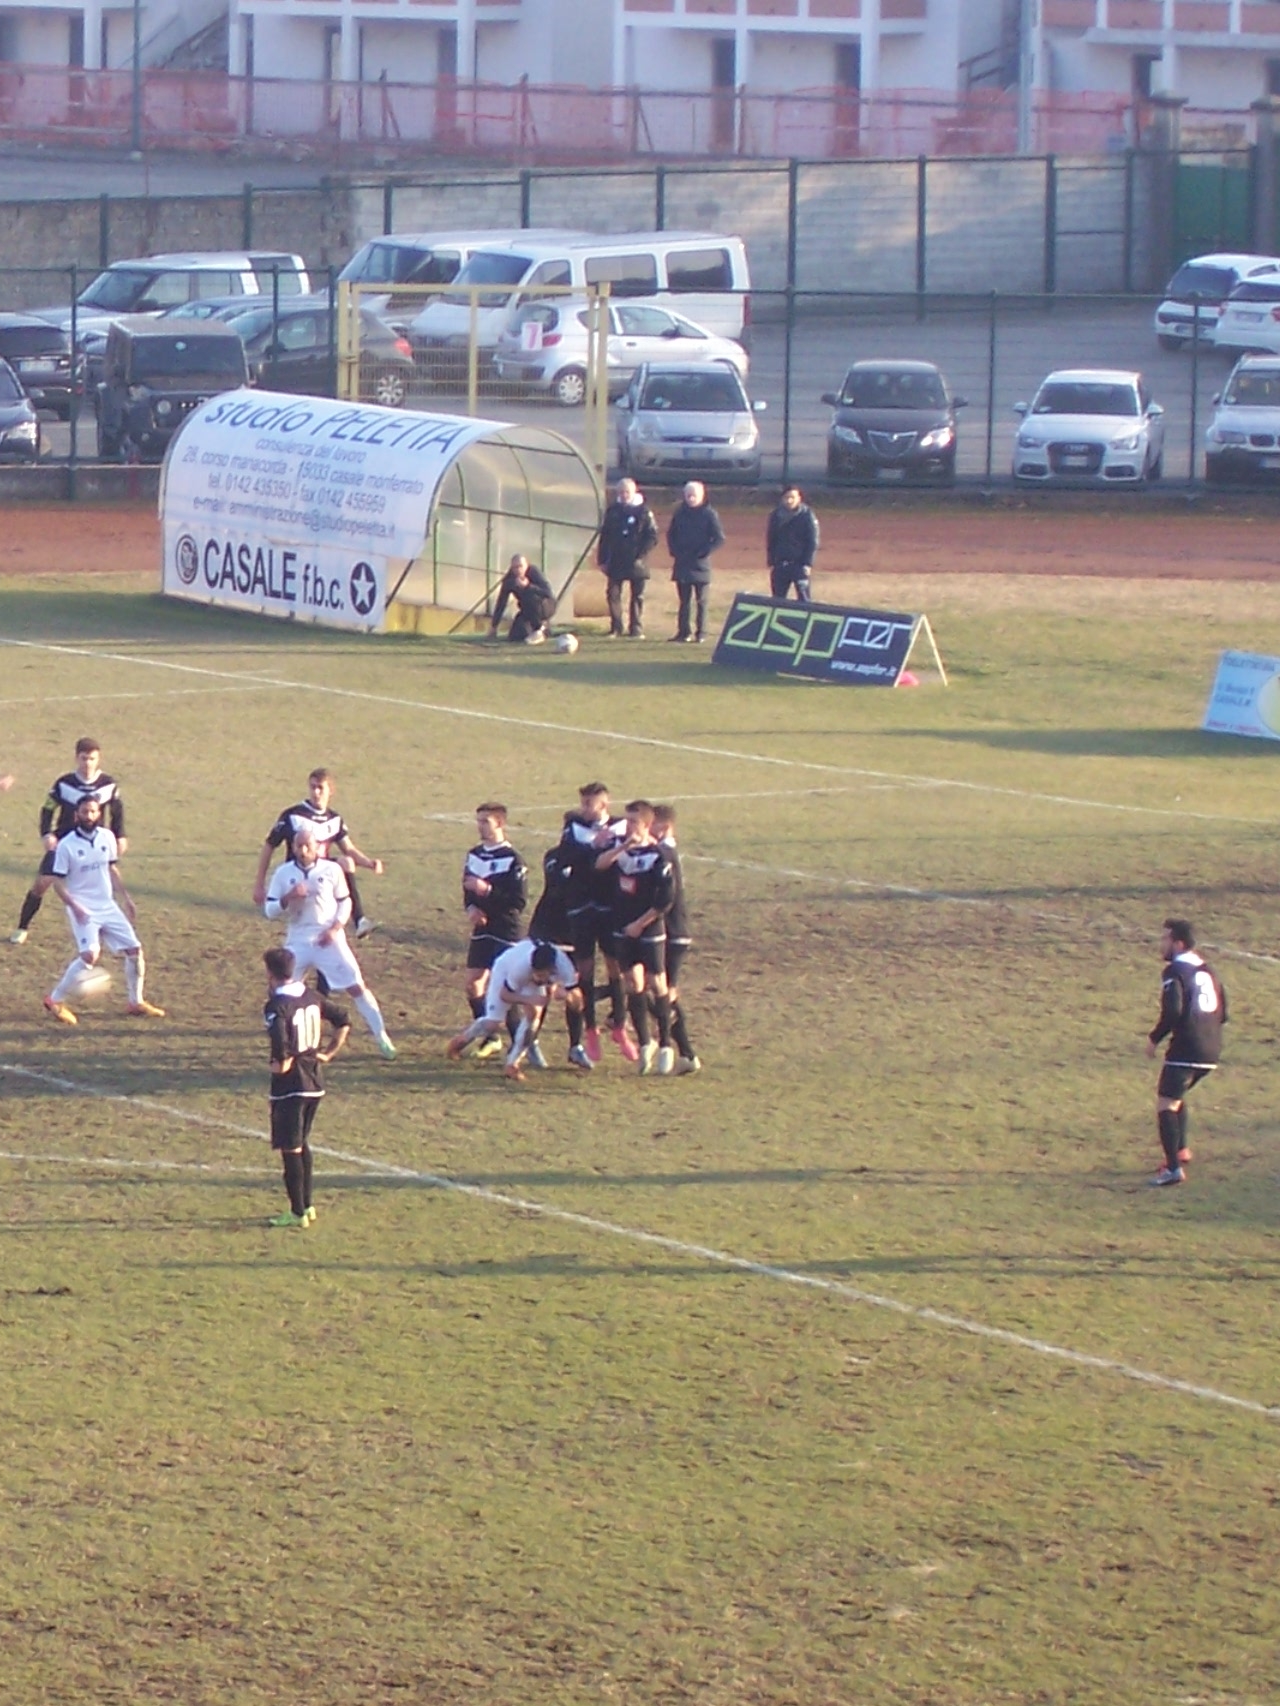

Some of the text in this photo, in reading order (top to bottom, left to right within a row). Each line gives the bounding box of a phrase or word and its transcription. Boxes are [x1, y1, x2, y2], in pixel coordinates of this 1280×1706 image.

[205, 398, 471, 455] studio PELETTA
[329, 470, 366, 487] casale
[203, 537, 345, 612] CASALE f.b.c.
[1194, 970, 1219, 1014] 3
[291, 1004, 322, 1054] 10
